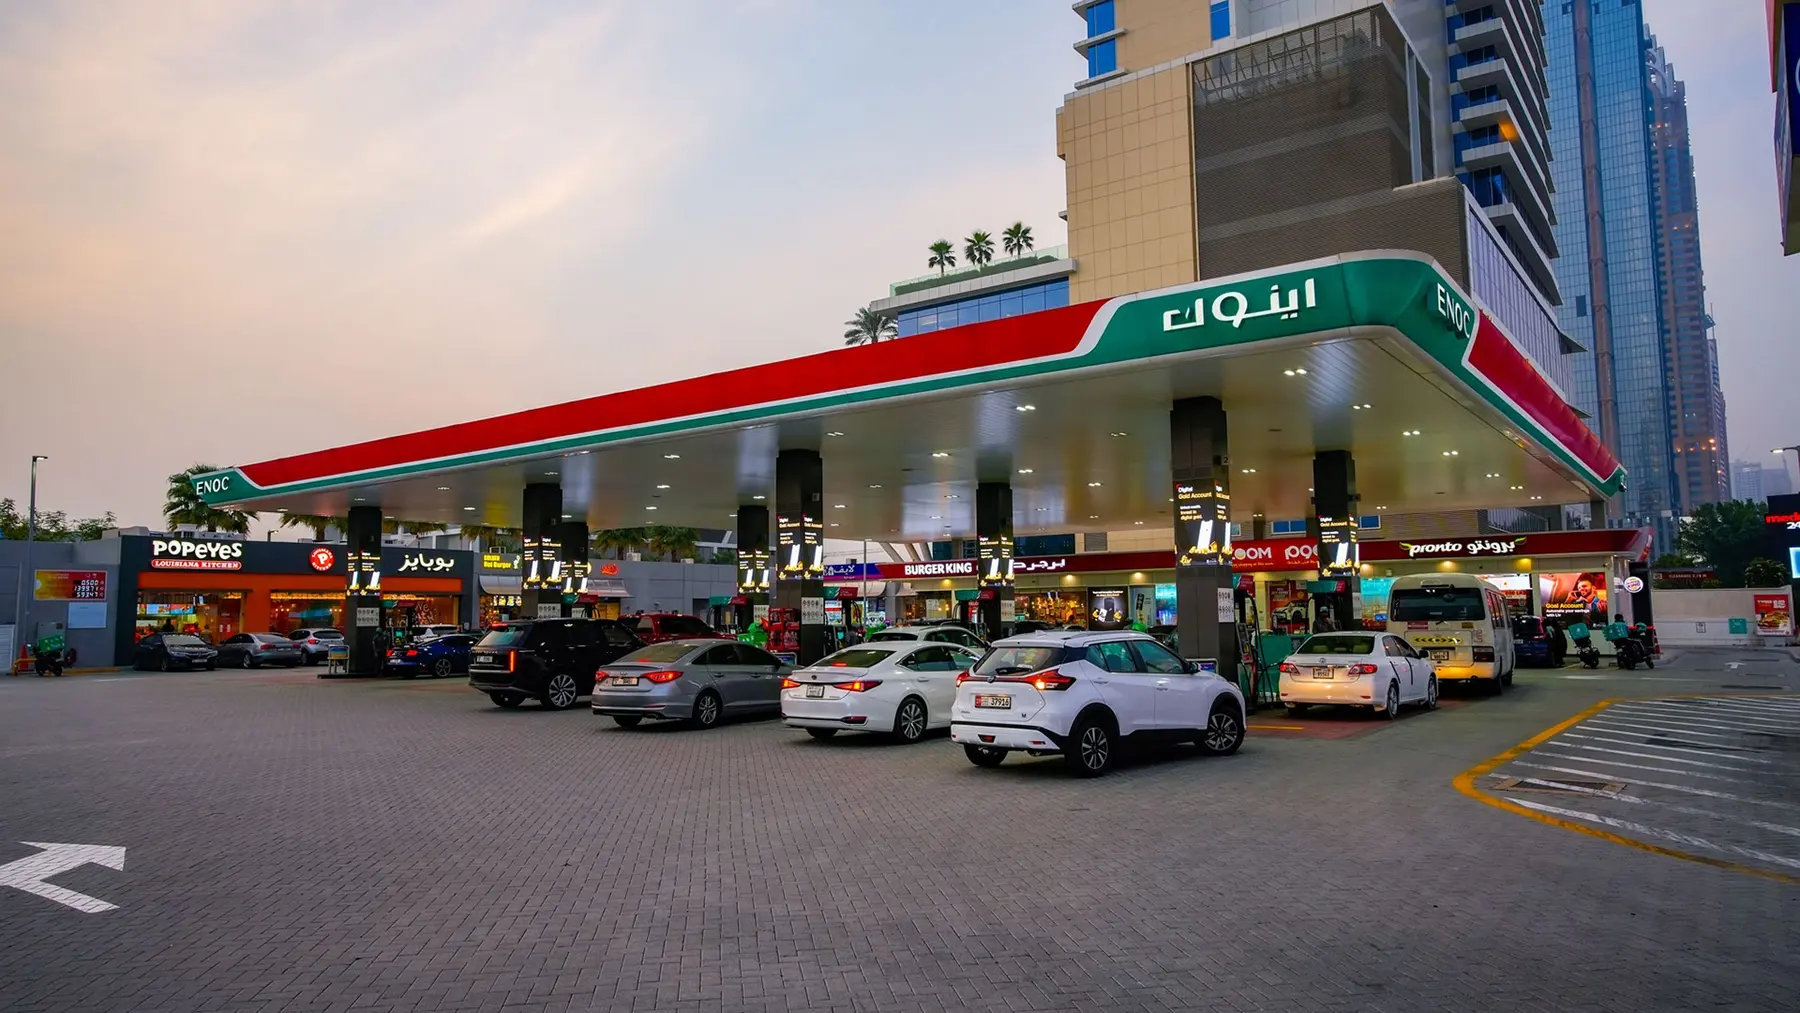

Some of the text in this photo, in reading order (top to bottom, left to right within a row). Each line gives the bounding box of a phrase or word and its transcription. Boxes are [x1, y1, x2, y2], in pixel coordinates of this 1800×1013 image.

[1437, 282, 1470, 338] ENOC
[196, 476, 229, 495] ENOC
[1232, 547, 1272, 560] OOM
[1409, 542, 1462, 557] pronto
[155, 560, 238, 569] LOUISIANA KITCHEN
[317, 553, 329, 564] P
[397, 553, 455, 572] بوبايز
[904, 562, 972, 576] BURGER KING
[990, 698, 1009, 706] 37916
